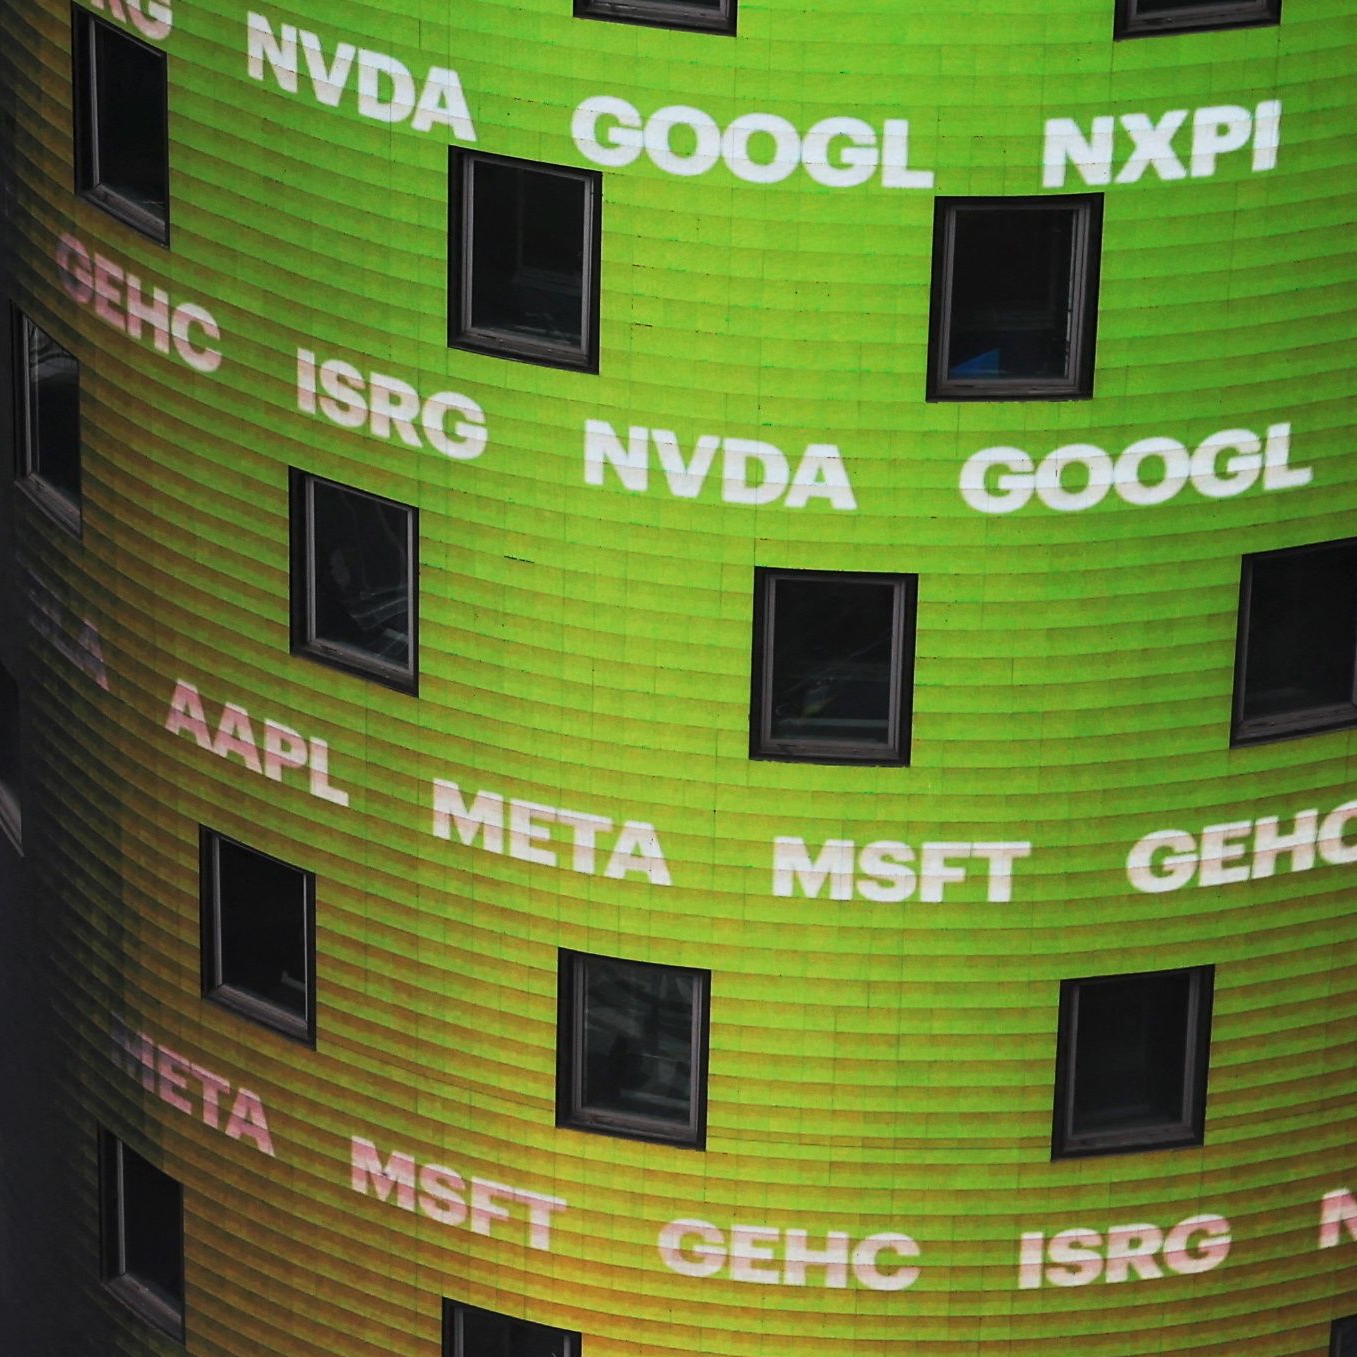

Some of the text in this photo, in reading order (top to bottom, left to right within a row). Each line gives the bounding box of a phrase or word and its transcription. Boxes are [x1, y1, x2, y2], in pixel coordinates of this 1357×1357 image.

[246, 12, 477, 141] NVDA
[570, 95, 935, 190] GOOGL
[1042, 100, 1282, 188] NXPI
[56, 233, 1313, 514] GEHC ISRG NVDA GOOGL
[165, 680, 1357, 903] AAPL META MSFT GEHC
[110, 1011, 275, 1157] META
[350, 1135, 567, 1252] MSFT
[656, 1217, 921, 1291] GEHC
[1018, 1214, 1231, 1290] ISRG
